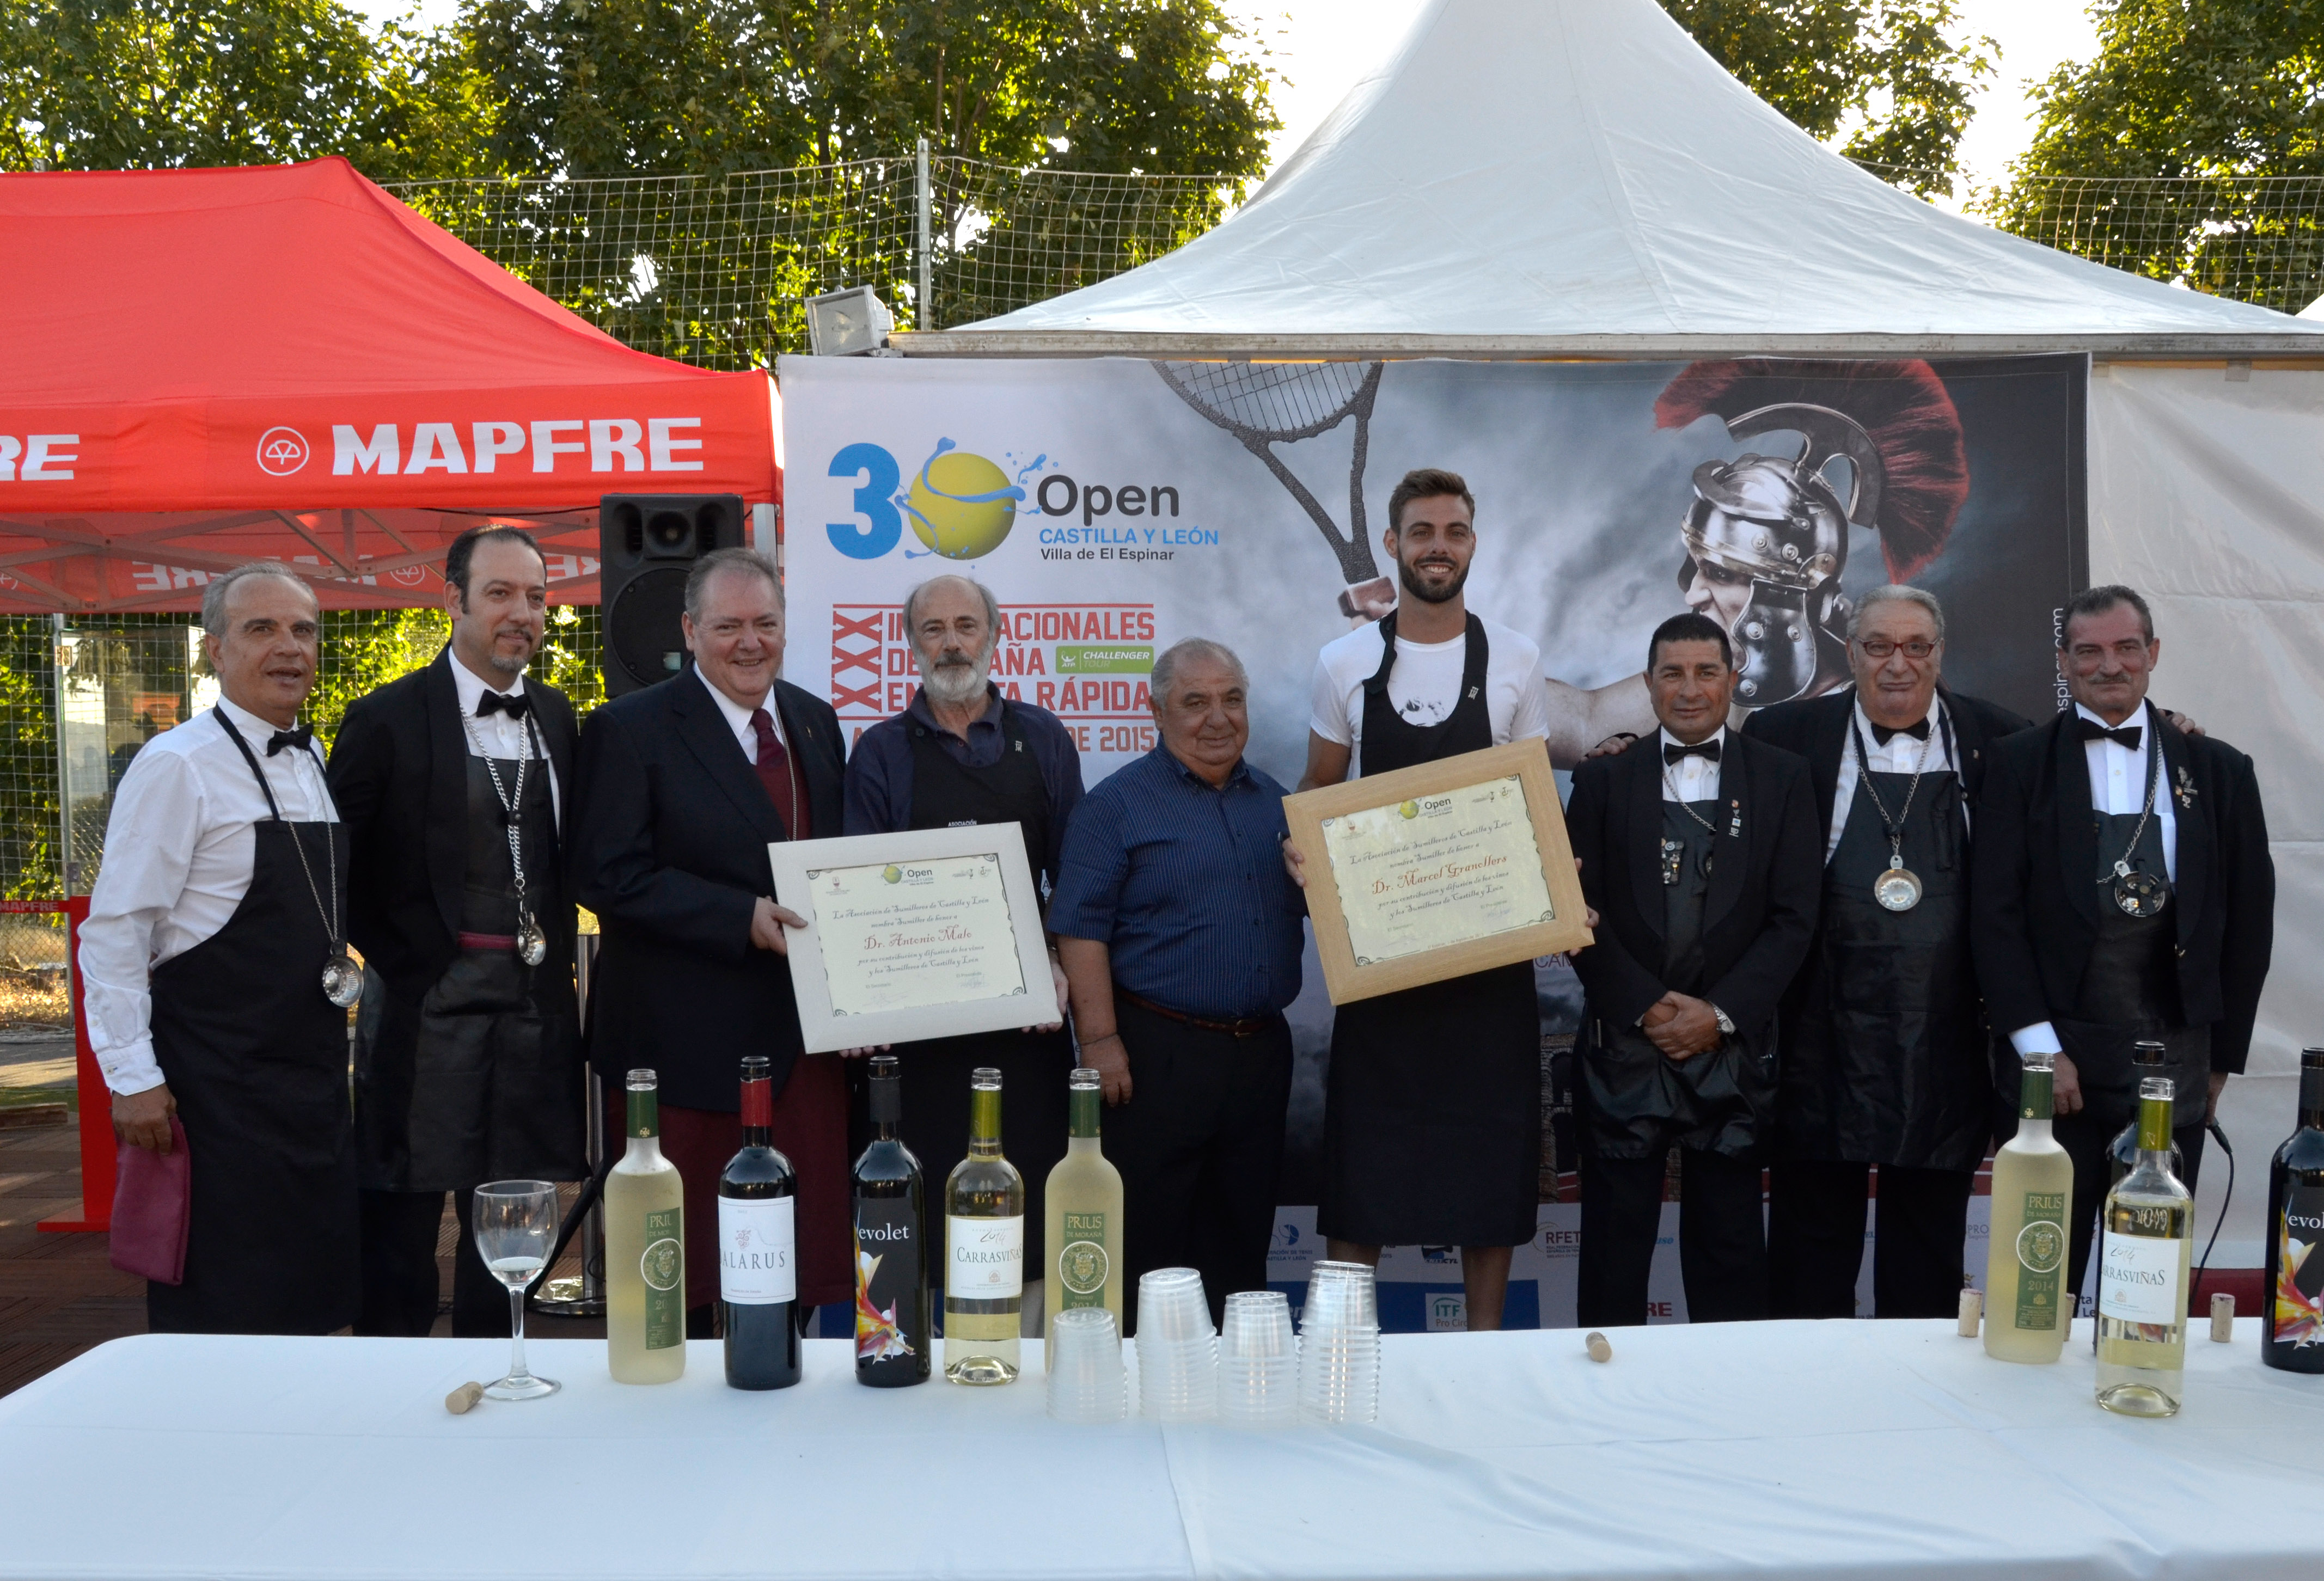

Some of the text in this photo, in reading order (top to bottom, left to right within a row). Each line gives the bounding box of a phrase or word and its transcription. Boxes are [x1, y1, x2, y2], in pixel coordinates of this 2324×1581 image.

[333, 416, 704, 476] MAPFRE
[1037, 474, 1179, 526] Open
[1039, 525, 1219, 545] CASTILLA Y LEÓN
[1041, 548, 1175, 562] Villa de El Espinar
[1083, 651, 1149, 660] CHALLENGER
[1084, 660, 1110, 668] TOUR
[1036, 676, 1152, 712] RÁPIDA
[1099, 726, 1154, 752] 2015
[1424, 798, 1451, 810] Open
[1458, 825, 1487, 837] Castilla
[1487, 826, 1493, 834] y
[1493, 820, 1512, 829] León
[907, 869, 933, 879] Open
[1397, 866, 1444, 888] Marcel
[1445, 854, 1507, 878] Granollers
[1451, 890, 1479, 901] Castilla
[1485, 885, 1503, 893] León
[0, 901, 59, 911] MAPFRE
[938, 899, 964, 908] Castilla
[971, 896, 989, 905] León
[889, 933, 935, 947] Antonio
[938, 924, 972, 941] Malo
[928, 958, 955, 967] Castilla
[962, 955, 978, 964] León
[2028, 1196, 2062, 1209] PRIUS
[1067, 1216, 1102, 1229] PRIUS
[859, 1222, 910, 1241] evolet
[980, 1228, 1007, 1246] 2014
[1546, 1231, 1581, 1244] RFET
[720, 1251, 786, 1270] ALARUS
[2110, 1245, 2136, 1266] 2014
[2027, 1280, 2054, 1292] 2014
[1436, 1304, 1461, 1317] ITF
[1436, 1319, 1450, 1327] Pro
